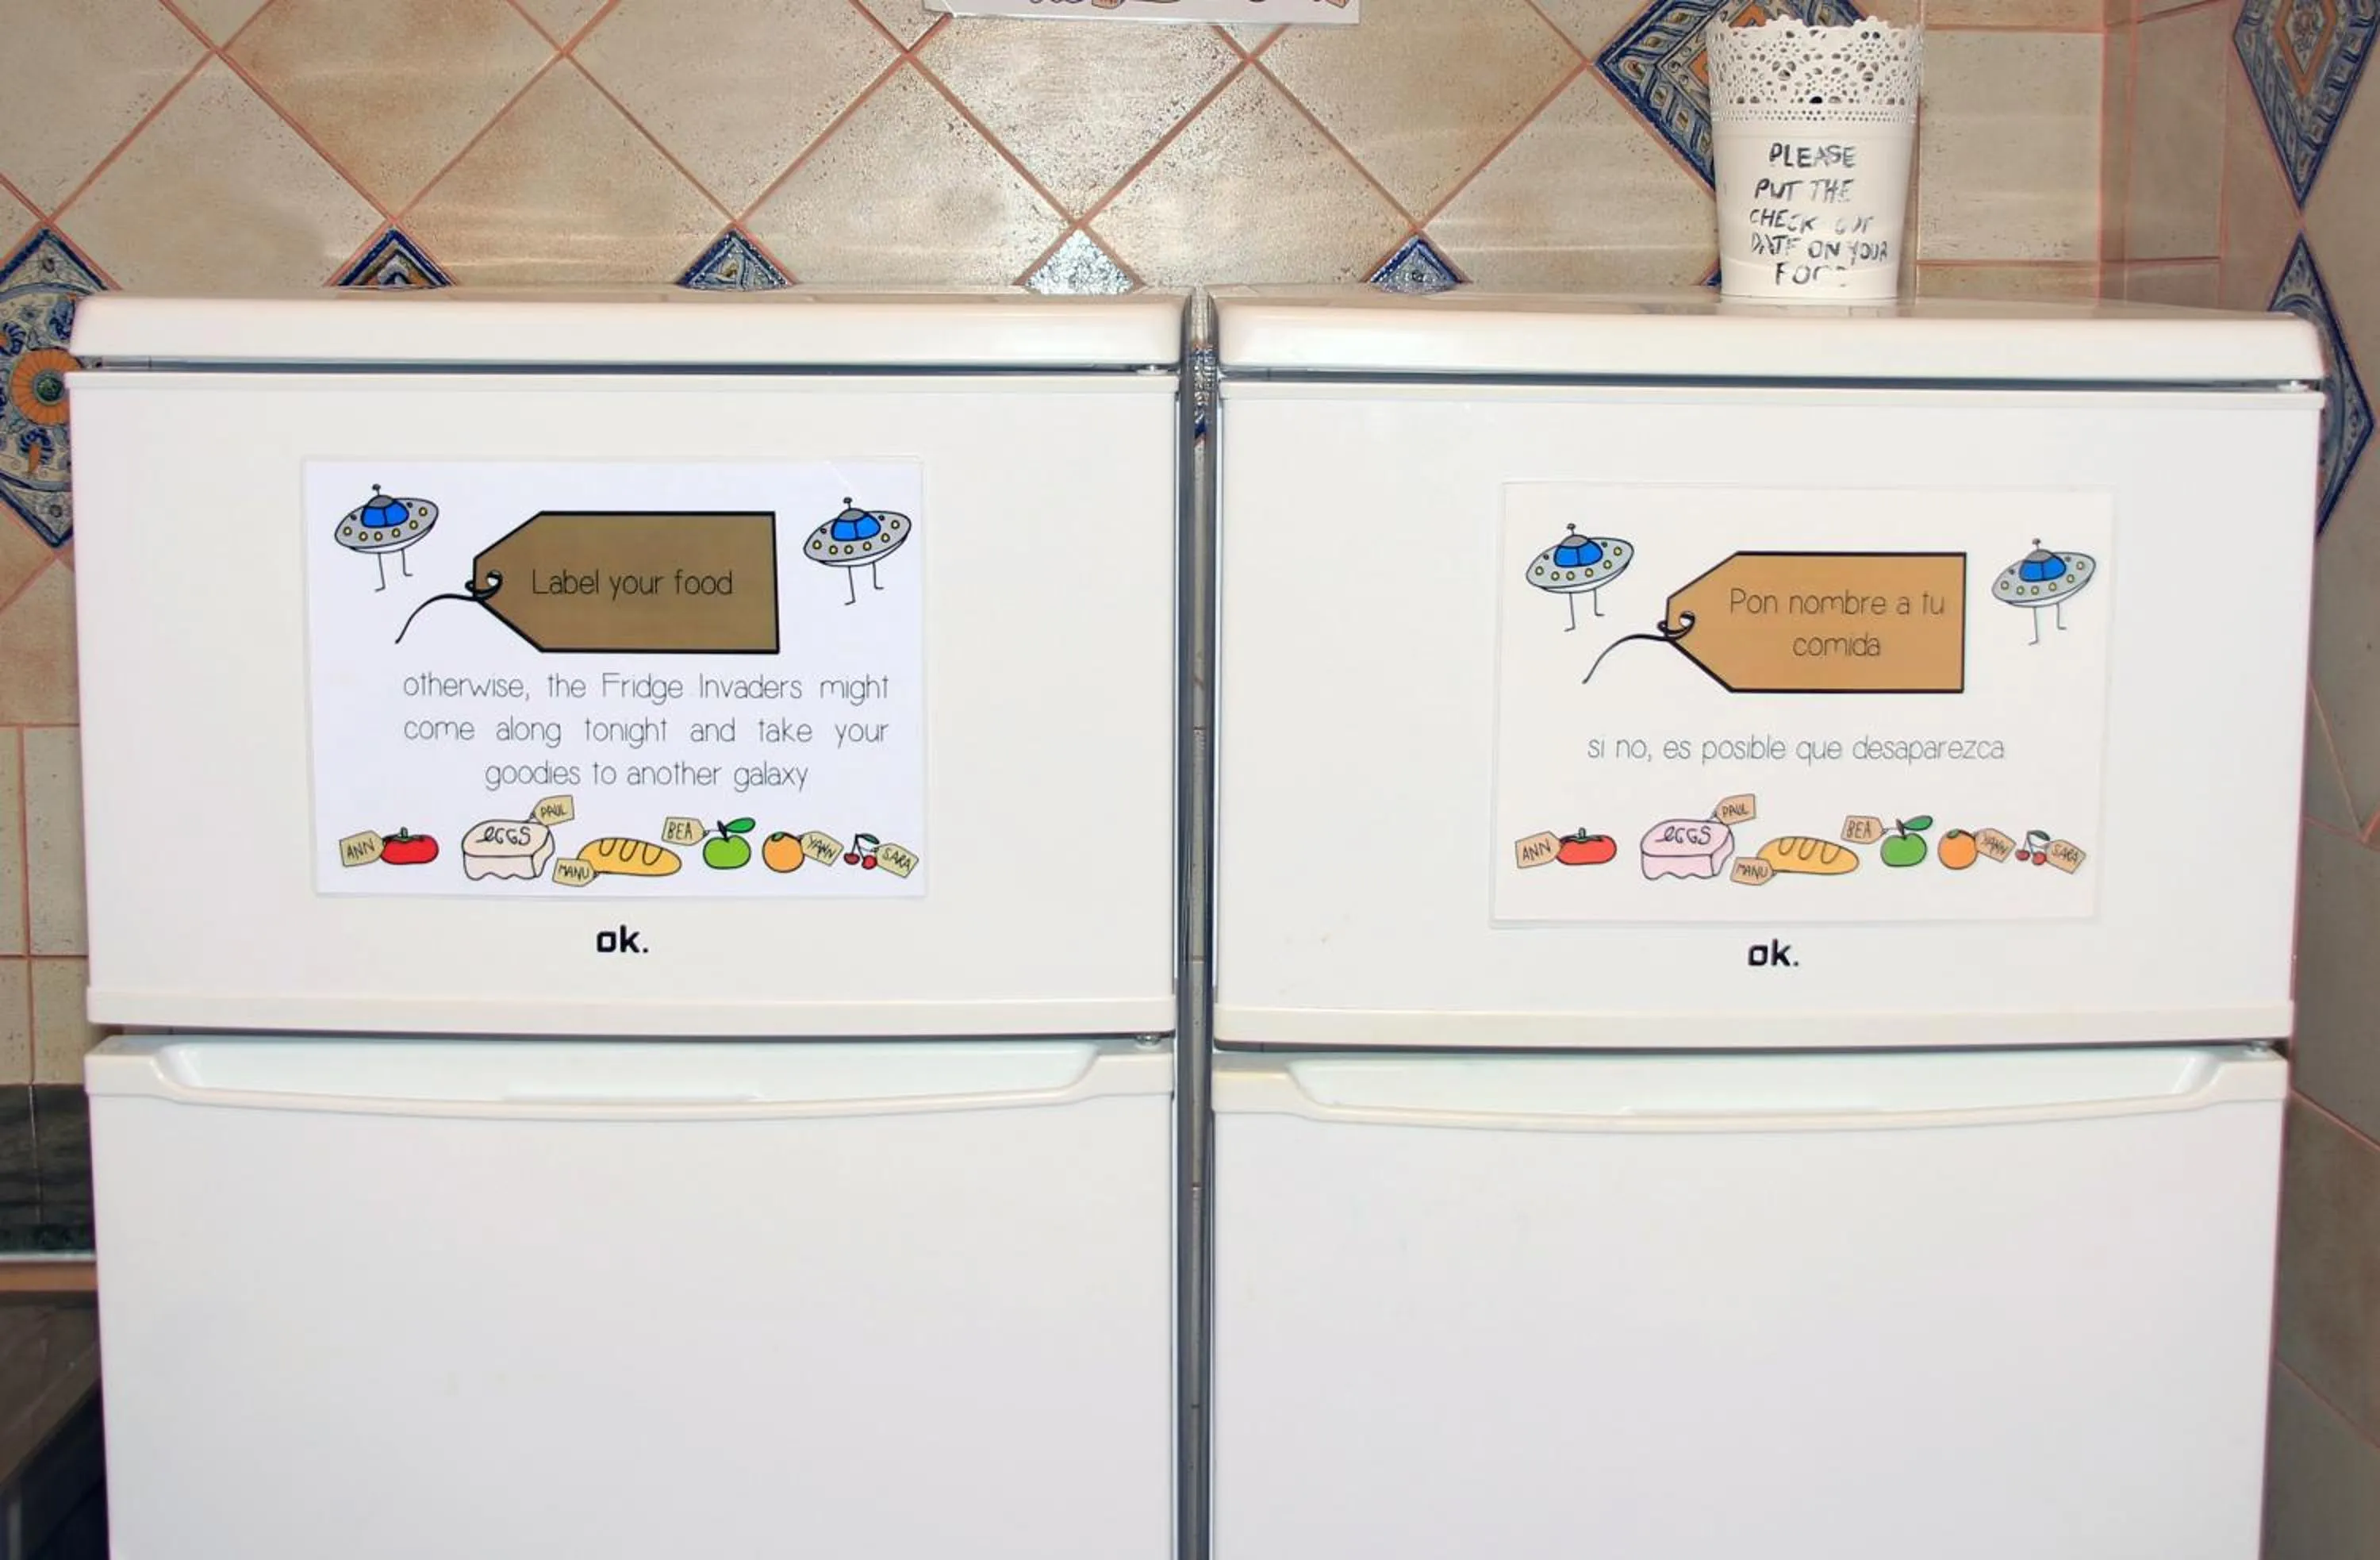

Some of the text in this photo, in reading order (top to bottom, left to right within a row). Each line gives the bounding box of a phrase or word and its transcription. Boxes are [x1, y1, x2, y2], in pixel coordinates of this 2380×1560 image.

[1768, 143, 1856, 168] PLEASE
[1753, 177, 1856, 203] PUT THE
[1749, 208, 1818, 234] CHECK
[1750, 232, 1888, 266] DATE ON YOUR
[1775, 260, 1847, 288] FO
[532, 568, 733, 602] Label your food
[1726, 587, 1944, 616] Pon nombre a tu
[1792, 632, 1881, 658] comida
[402, 670, 889, 708] otherwise, the Fridge Invaders might
[403, 714, 889, 751] come along tonight and take your
[1587, 733, 2006, 768] si no, es posible que desaparezca
[485, 759, 808, 793] goodies to another galaxy
[539, 802, 569, 817] PAUL
[1721, 803, 1750, 818] PAUL
[667, 821, 693, 840] BEA
[1846, 820, 1872, 840] BEA
[347, 840, 376, 859] ANN
[807, 836, 837, 859] YANN
[881, 847, 913, 871] SARA
[1522, 839, 1553, 862] ANN
[557, 863, 590, 880] MANU
[1737, 863, 1769, 880] MANU
[596, 923, 650, 955] ok.
[1747, 937, 1800, 968] ok.
